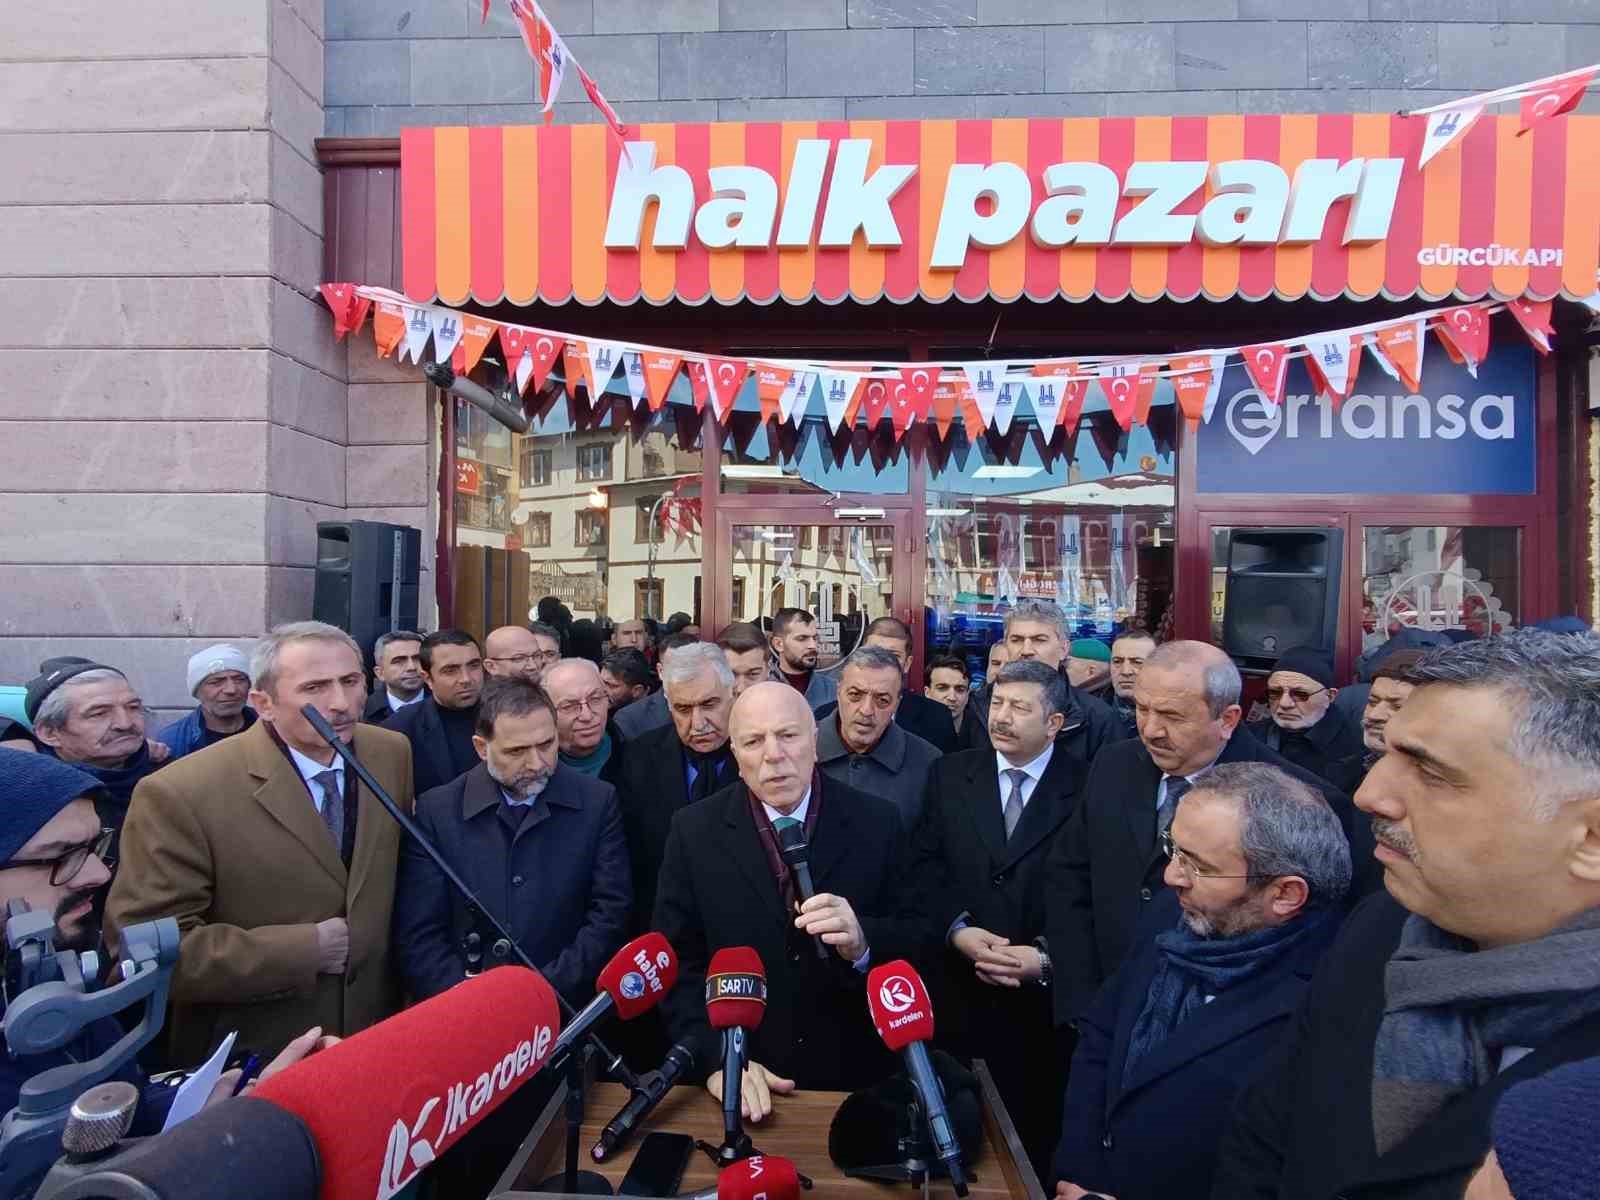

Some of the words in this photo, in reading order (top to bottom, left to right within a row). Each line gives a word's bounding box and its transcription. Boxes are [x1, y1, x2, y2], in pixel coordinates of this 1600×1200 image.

[604, 138, 918, 250] halk
[929, 156, 1405, 272] pazarı
[1416, 243, 1564, 267] GÜRCÜKAPI
[633, 949, 664, 993] haber
